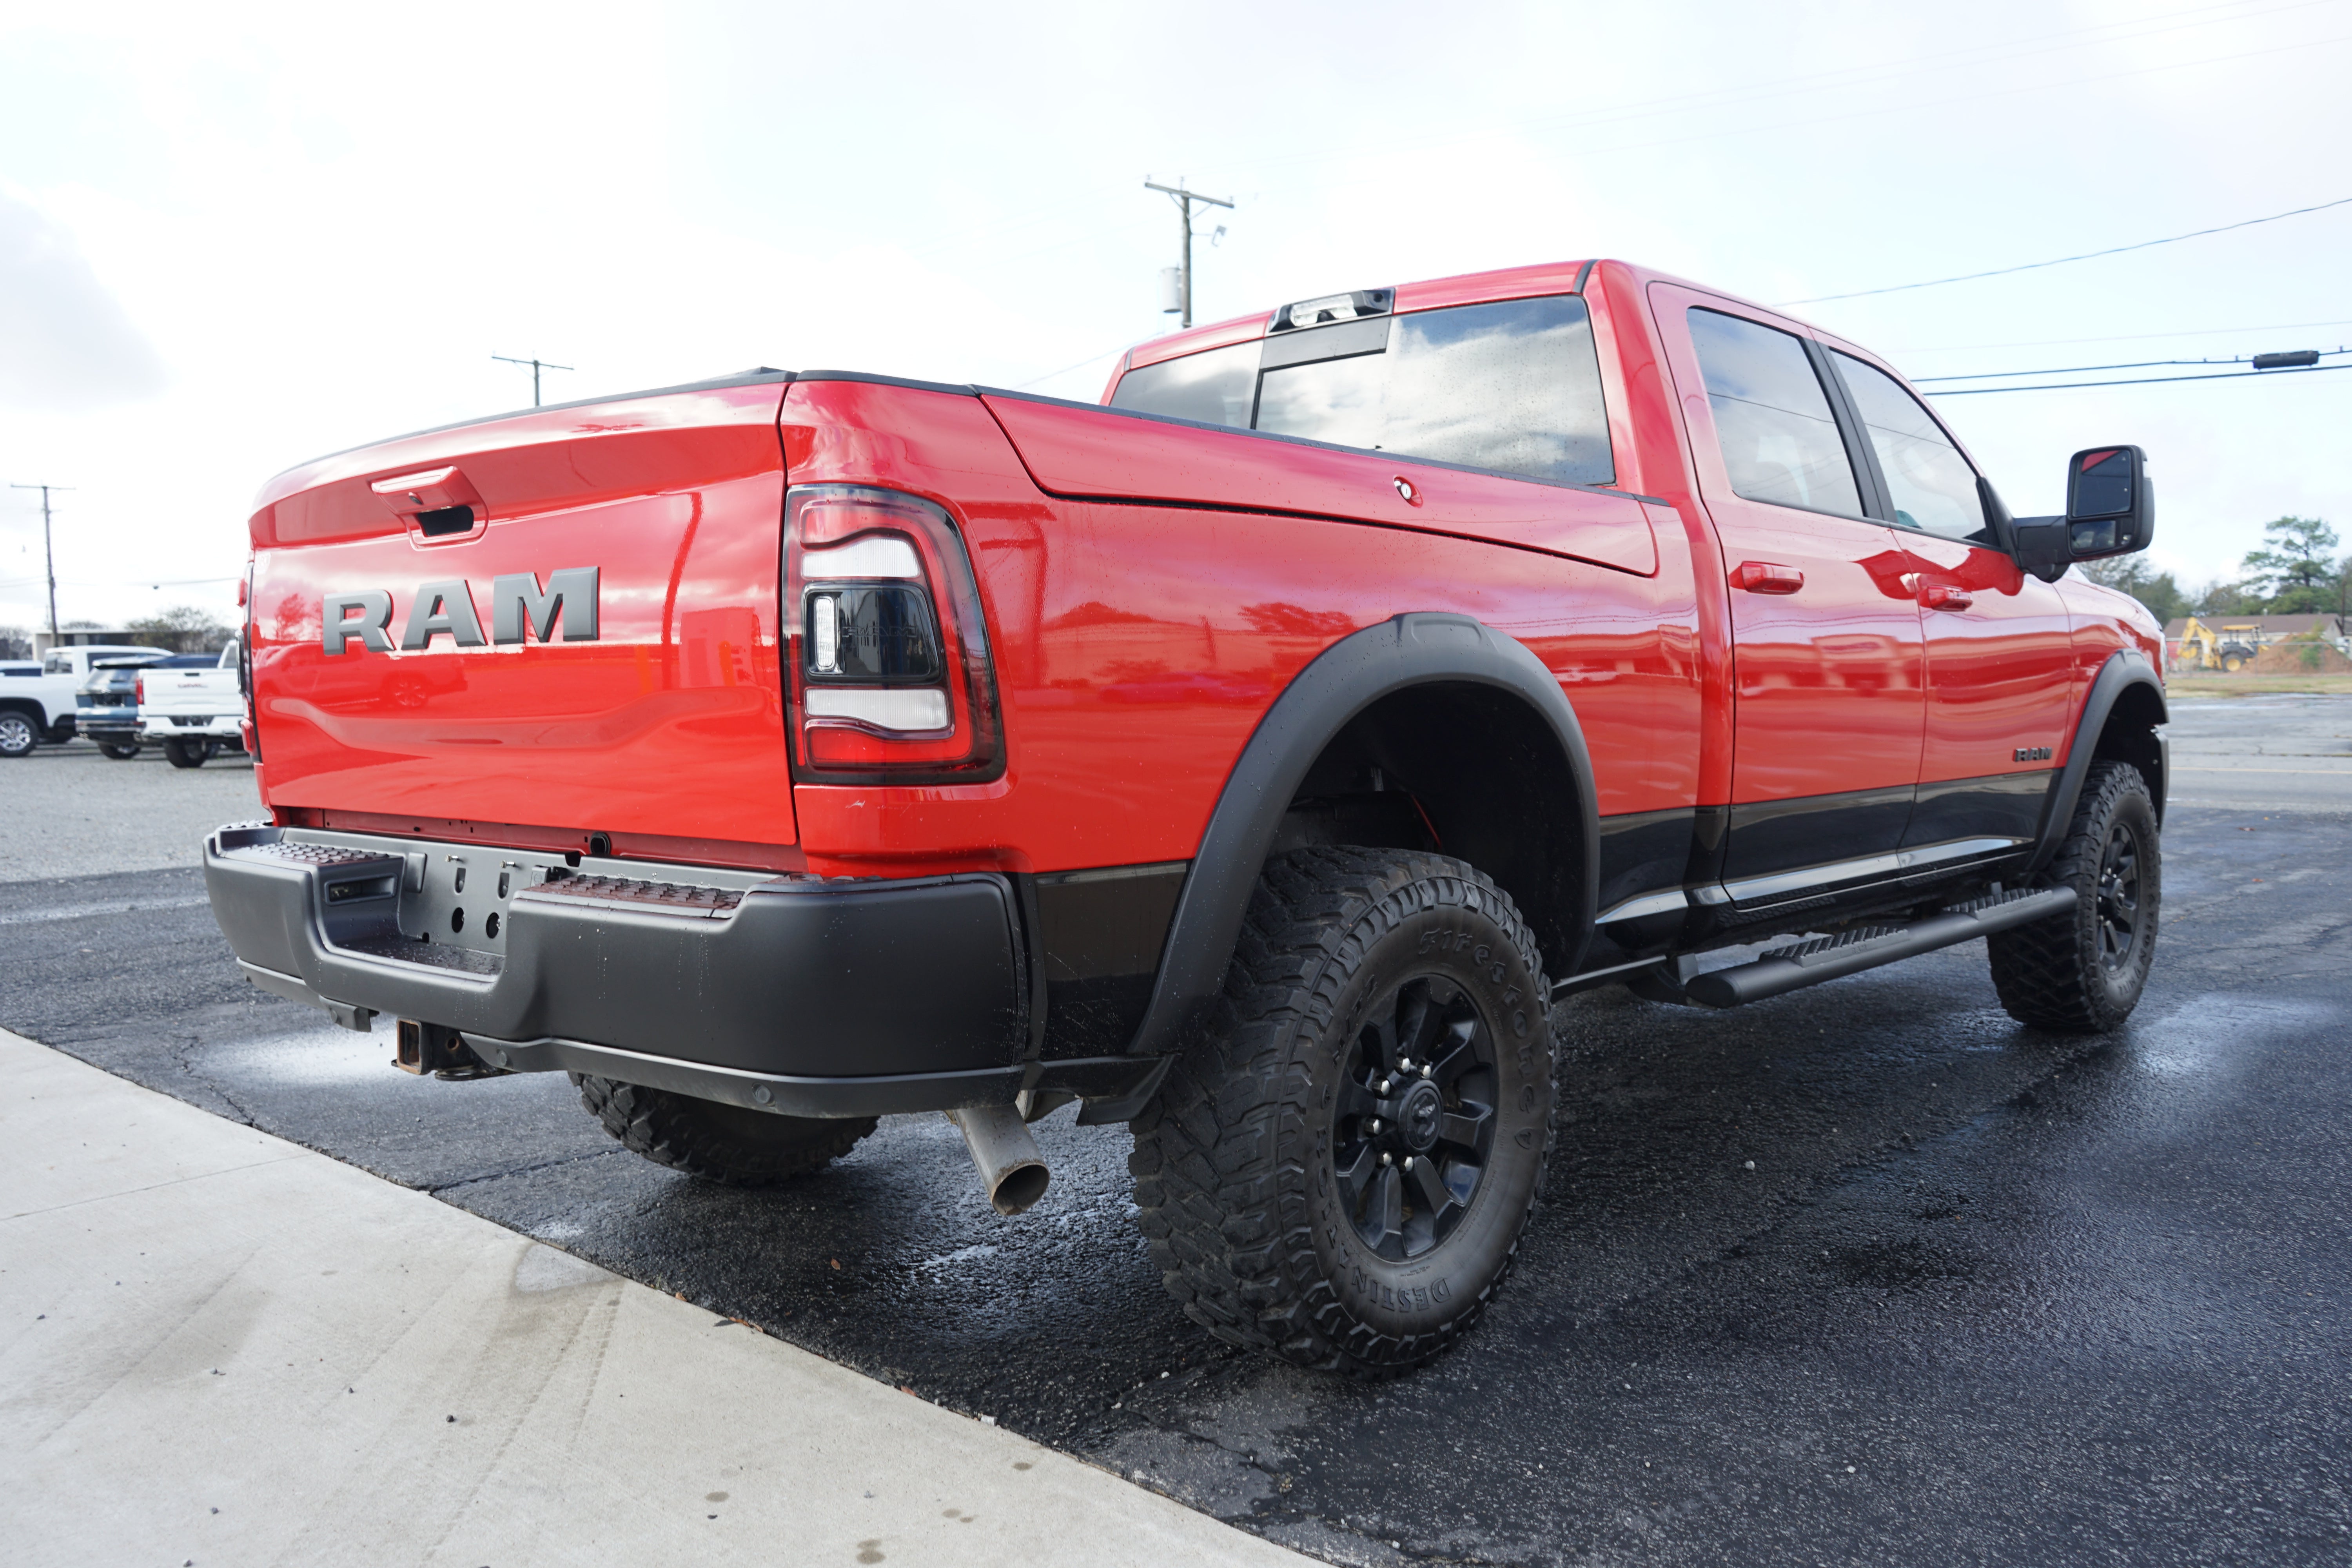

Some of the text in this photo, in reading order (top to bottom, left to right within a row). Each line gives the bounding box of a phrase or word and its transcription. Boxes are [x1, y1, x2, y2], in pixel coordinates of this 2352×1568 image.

[323, 566, 601, 655] RAM
[842, 626, 917, 638] RAM
[2014, 746, 2052, 762] RAM
[1418, 927, 1535, 1114] Firestone
[1316, 1125, 1453, 1313] DESTINATION
